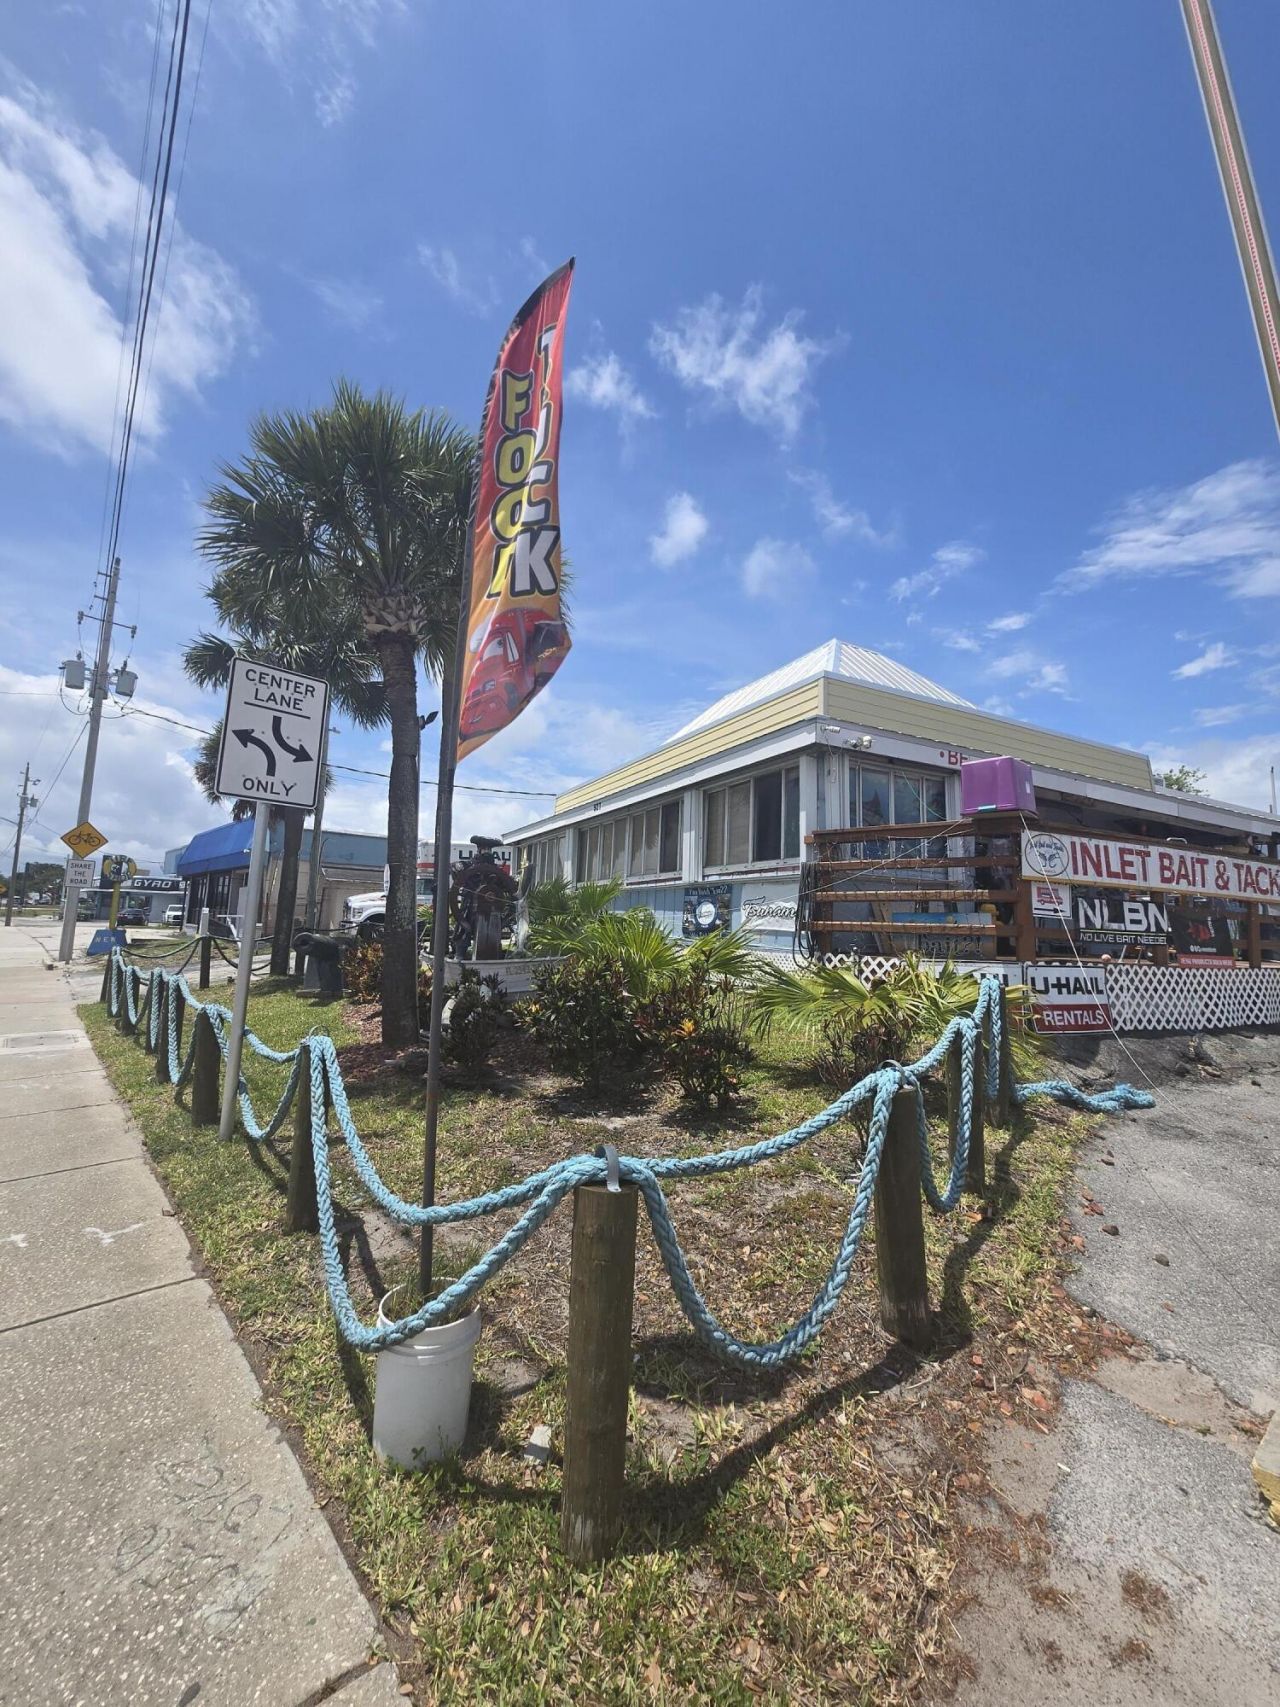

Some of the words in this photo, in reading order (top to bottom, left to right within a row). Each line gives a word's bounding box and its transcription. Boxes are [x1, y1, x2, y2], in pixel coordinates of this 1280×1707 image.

[245, 668, 316, 698] CENTER
[254, 687, 303, 711] LANE
[242, 777, 297, 797] ONLY
[70, 862, 93, 870] SHARE
[1071, 841, 1151, 882] INLET
[1158, 852, 1209, 888] BAIT
[1215, 859, 1230, 891] &
[133, 879, 173, 888] GYRO
[742, 896, 798, 919] Tsunam
[1077, 897, 1168, 932] NLBN
[1080, 932, 1093, 941] NO
[1094, 933, 1115, 943] LIVE
[1116, 935, 1136, 943] BAIT
[1030, 976, 1105, 995] U-HAUL
[1042, 1010, 1104, 1026] RENTALS
